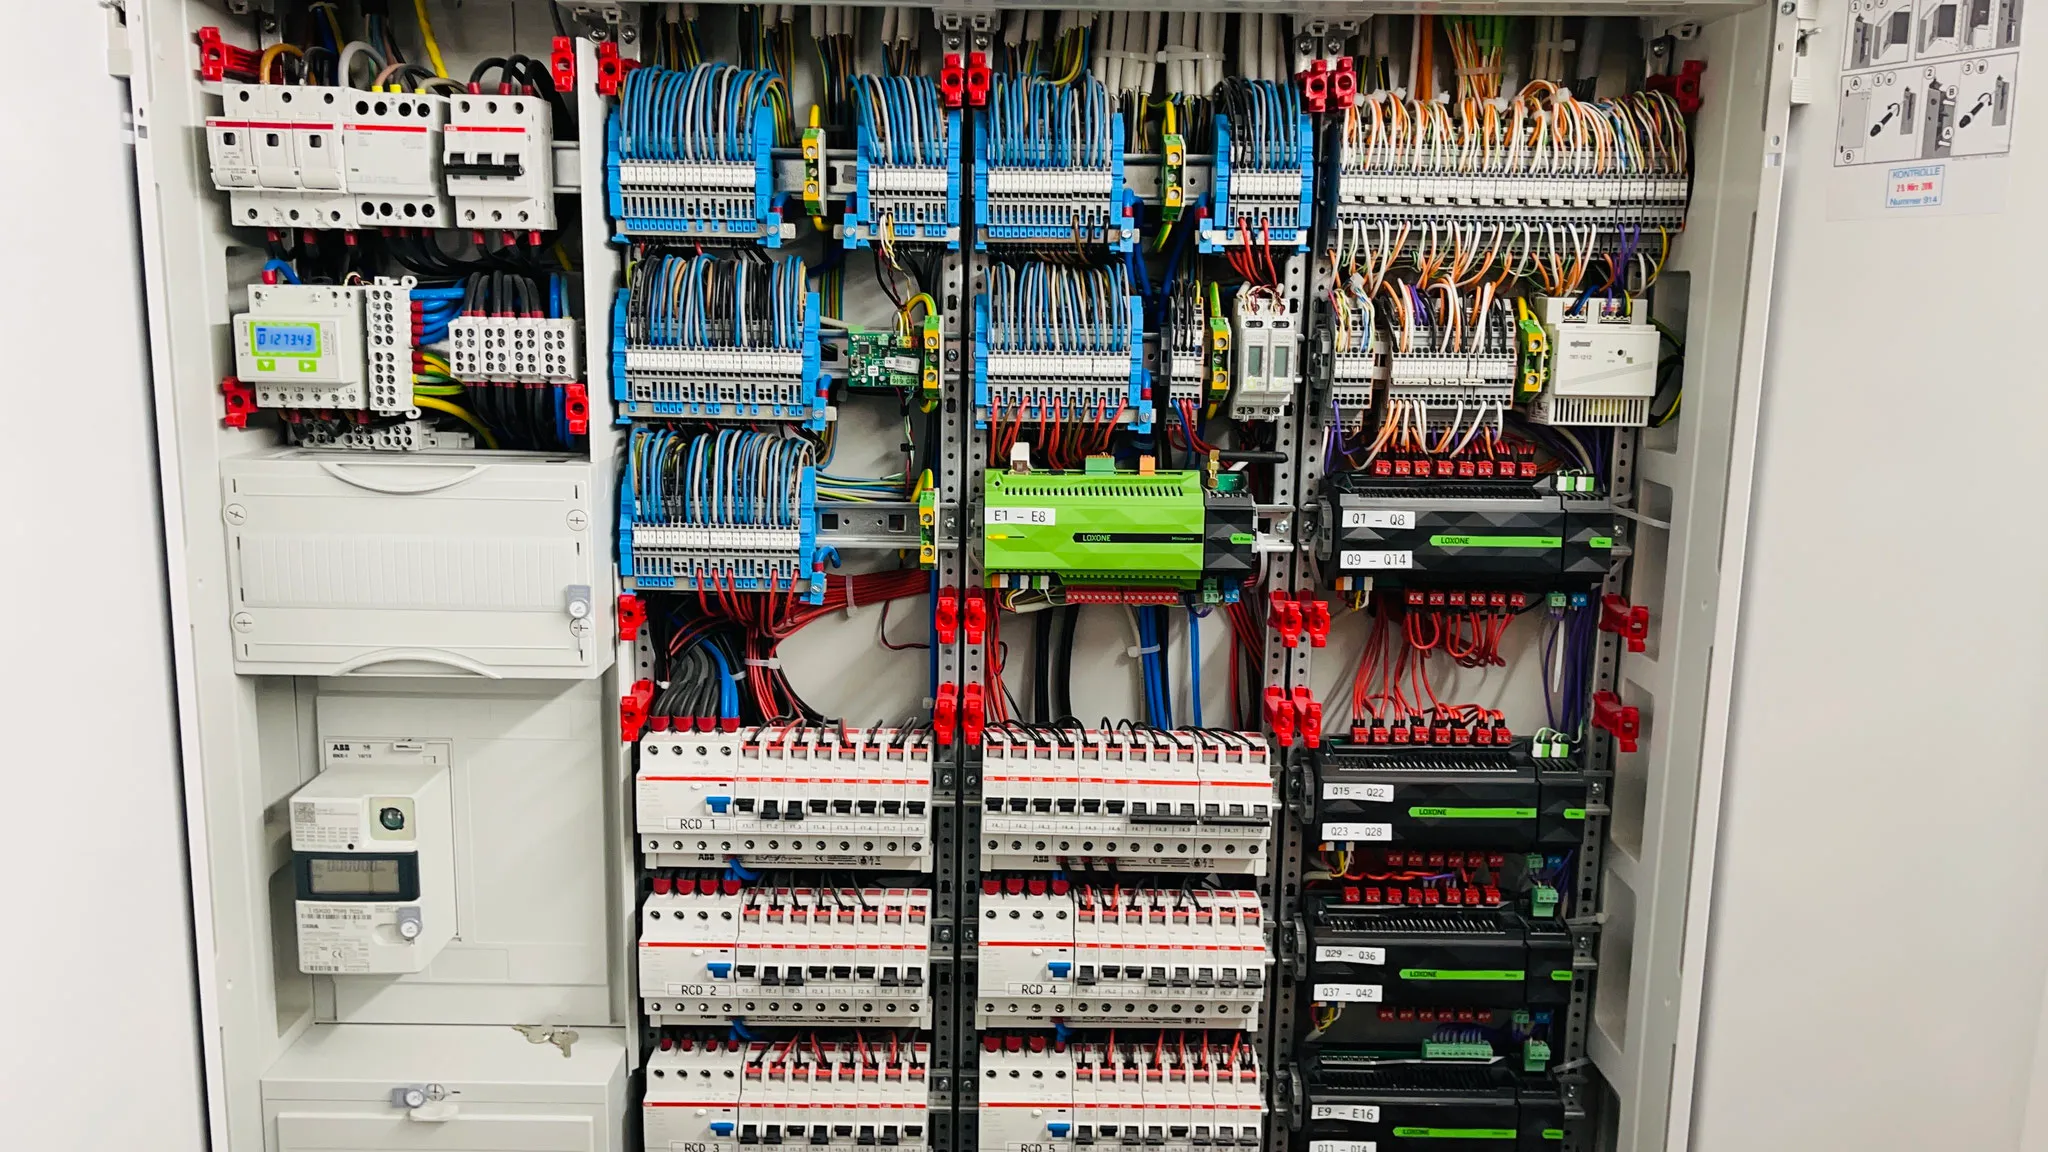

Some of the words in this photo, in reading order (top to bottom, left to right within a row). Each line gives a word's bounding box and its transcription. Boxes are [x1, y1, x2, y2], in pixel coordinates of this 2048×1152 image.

[1893, 167, 1940, 179] KONTROLLE
[995, 510, 1008, 521] E1
[1032, 511, 1046, 522] E8
[1352, 513, 1366, 524] Q1
[1390, 514, 1405, 526] Q8
[1082, 534, 1111, 542] LOXONE
[1347, 554, 1361, 565] Q9
[1384, 554, 1406, 565] Q14
[332, 743, 351, 751] ABB
[1332, 787, 1350, 795] Q15
[1366, 788, 1384, 798] Q22
[680, 818, 702, 829] RCD
[710, 819, 715, 830] 1
[1331, 827, 1348, 836] Q23
[1365, 827, 1382, 836] Q28
[698, 853, 715, 861] ABB
[1325, 949, 1342, 957] Q29
[1358, 951, 1376, 961] Q36
[681, 985, 703, 995] RCD
[710, 985, 716, 996] 2
[1022, 984, 1043, 995] RCD
[1050, 985, 1056, 995] 4
[1322, 988, 1340, 997] Q37
[1356, 988, 1373, 998] Q42
[1317, 1107, 1332, 1117] E9
[1352, 1108, 1373, 1120] E16
[684, 1143, 706, 1152] RCD
[713, 1143, 719, 1152] 3
[1021, 1144, 1042, 1152] RCD
[1049, 1144, 1055, 1152] 5
